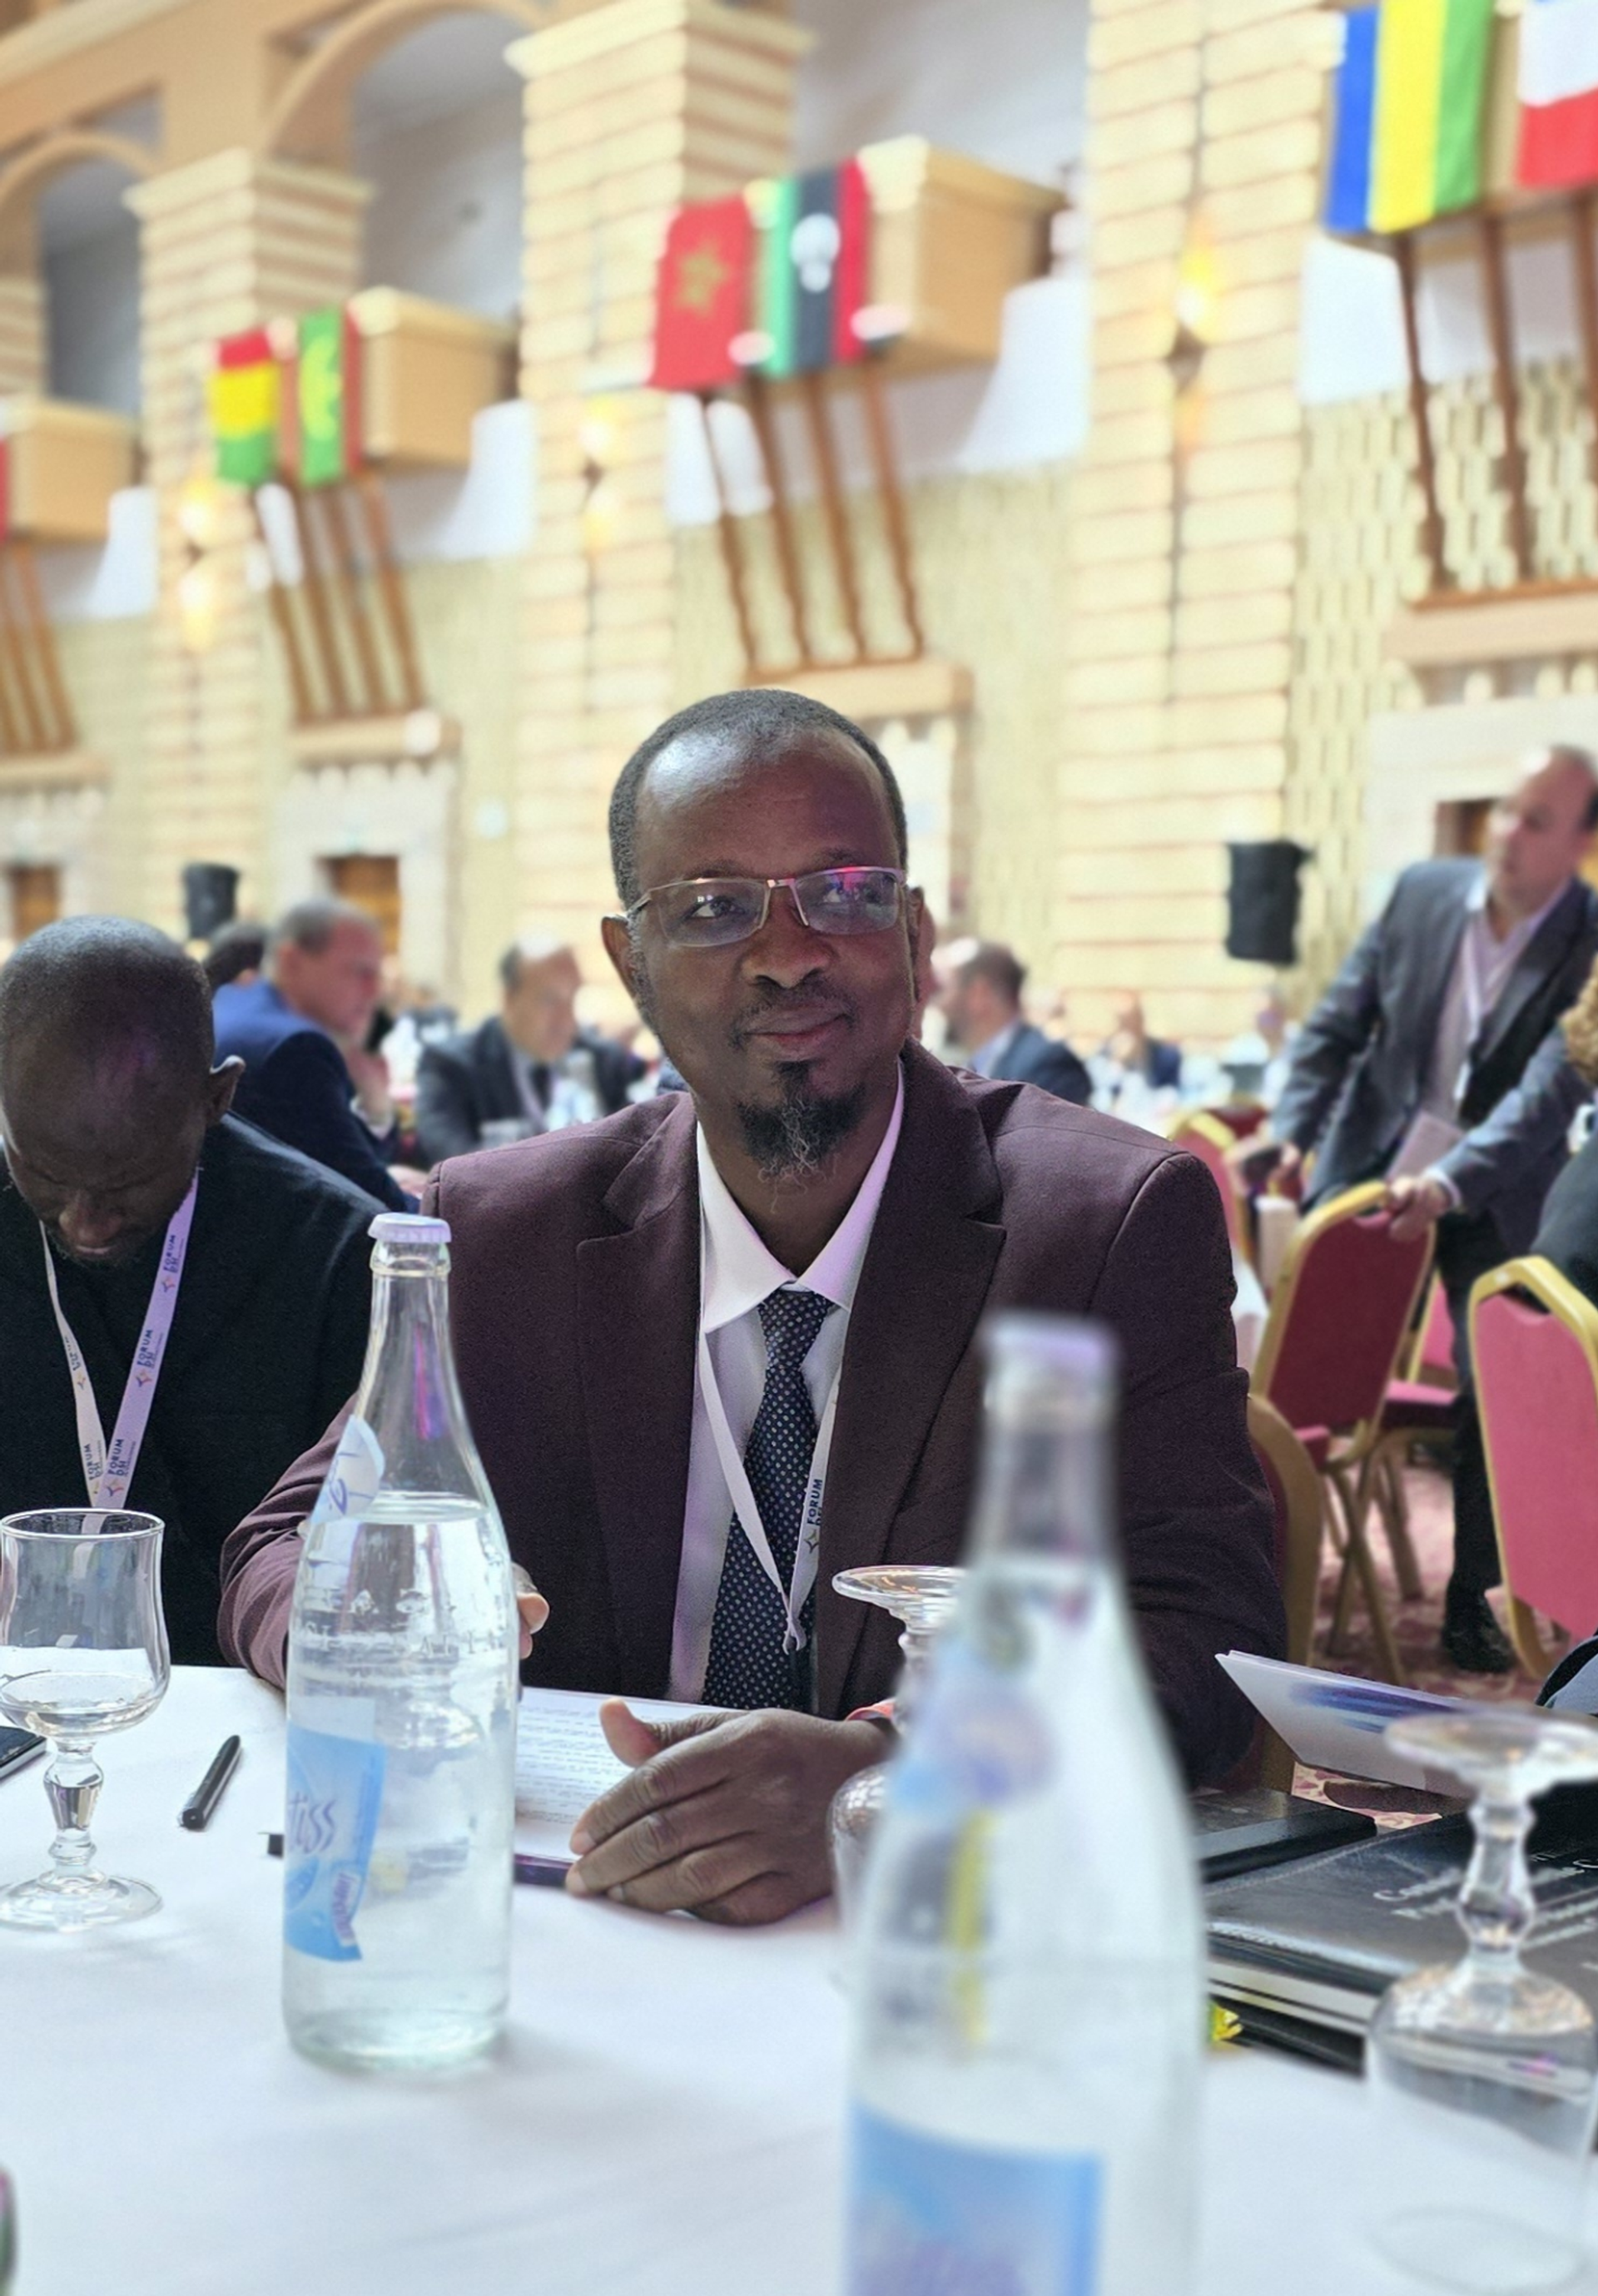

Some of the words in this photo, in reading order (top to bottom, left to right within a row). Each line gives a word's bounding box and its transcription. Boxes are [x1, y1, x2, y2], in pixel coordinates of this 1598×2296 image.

[163, 1234, 176, 1272] FORUM
[136, 1330, 153, 1366] FORUM
[84, 1443, 95, 1480] FORUM
[107, 1439, 124, 1475] FORUM
[806, 1479, 823, 1525] FORUM
